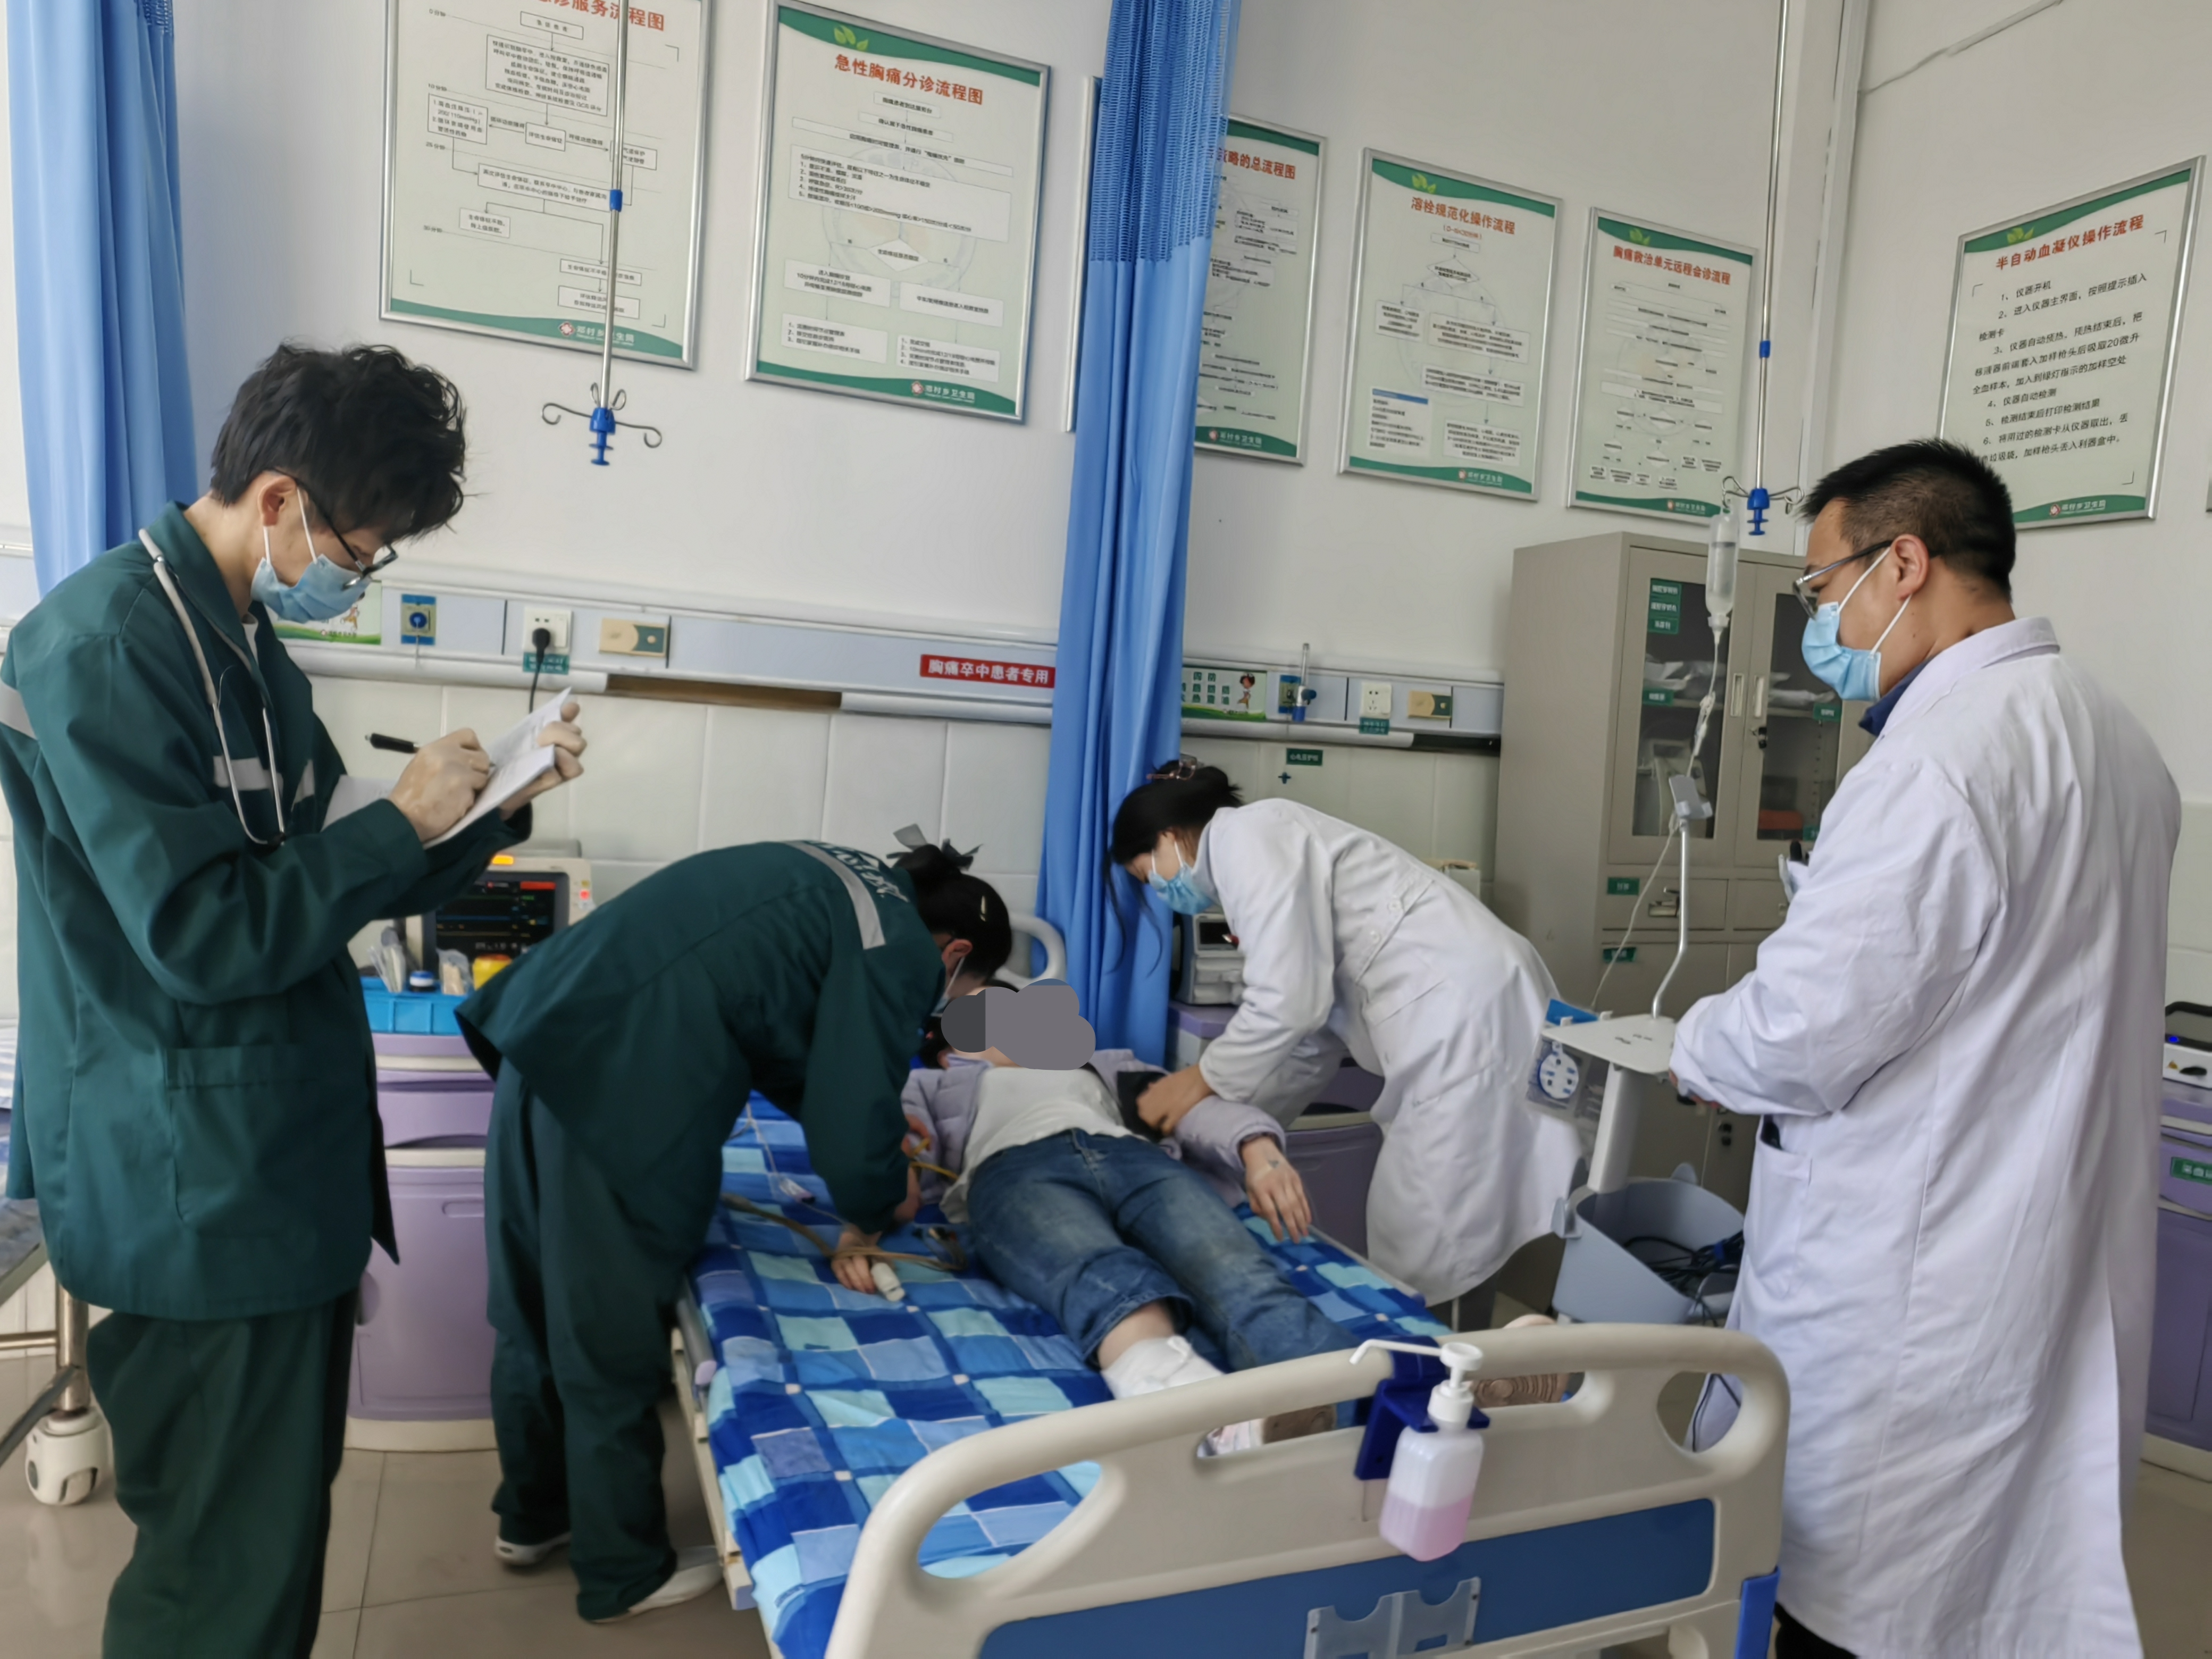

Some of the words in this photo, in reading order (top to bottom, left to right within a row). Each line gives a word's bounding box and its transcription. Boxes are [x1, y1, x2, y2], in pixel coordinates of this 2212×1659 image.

[835, 54, 983, 105] 急性胸痛分诊流程图
[1411, 196, 1515, 236] 溶栓规范化操作流程
[1996, 214, 2144, 270] 半自动血凝仪操作流程
[1613, 245, 1731, 286] 胸痛救治单元远程会诊流程
[1979, 328, 2005, 341] 检测卡
[928, 659, 1049, 684] 胸痛卒中患者专用
